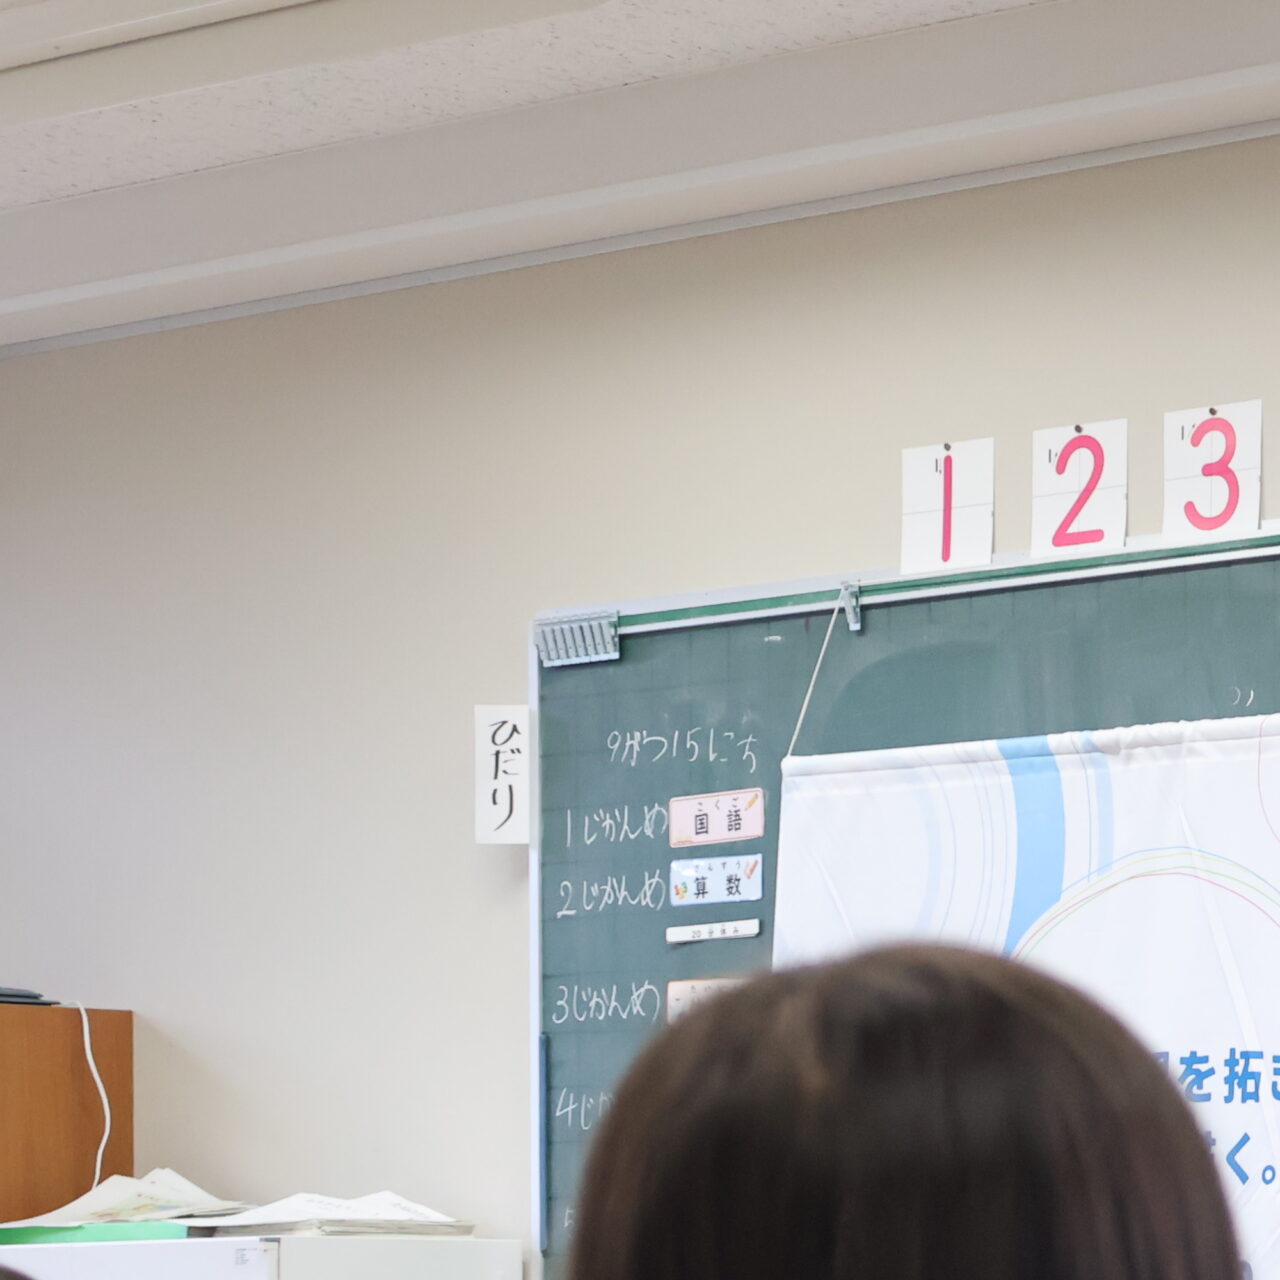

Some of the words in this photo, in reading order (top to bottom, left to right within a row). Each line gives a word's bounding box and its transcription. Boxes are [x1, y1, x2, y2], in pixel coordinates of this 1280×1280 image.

[1052, 435, 1105, 547] 2
[1184, 417, 1240, 530] 3
[941, 455, 953, 563] 1
[488, 719, 522, 831] ひだり
[606, 726, 758, 774] 9がつ15にち
[694, 809, 743, 836] 国語
[555, 868, 668, 918] 2じかんめ
[694, 874, 742, 899] 算数
[552, 979, 661, 1024] 3じかんめ
